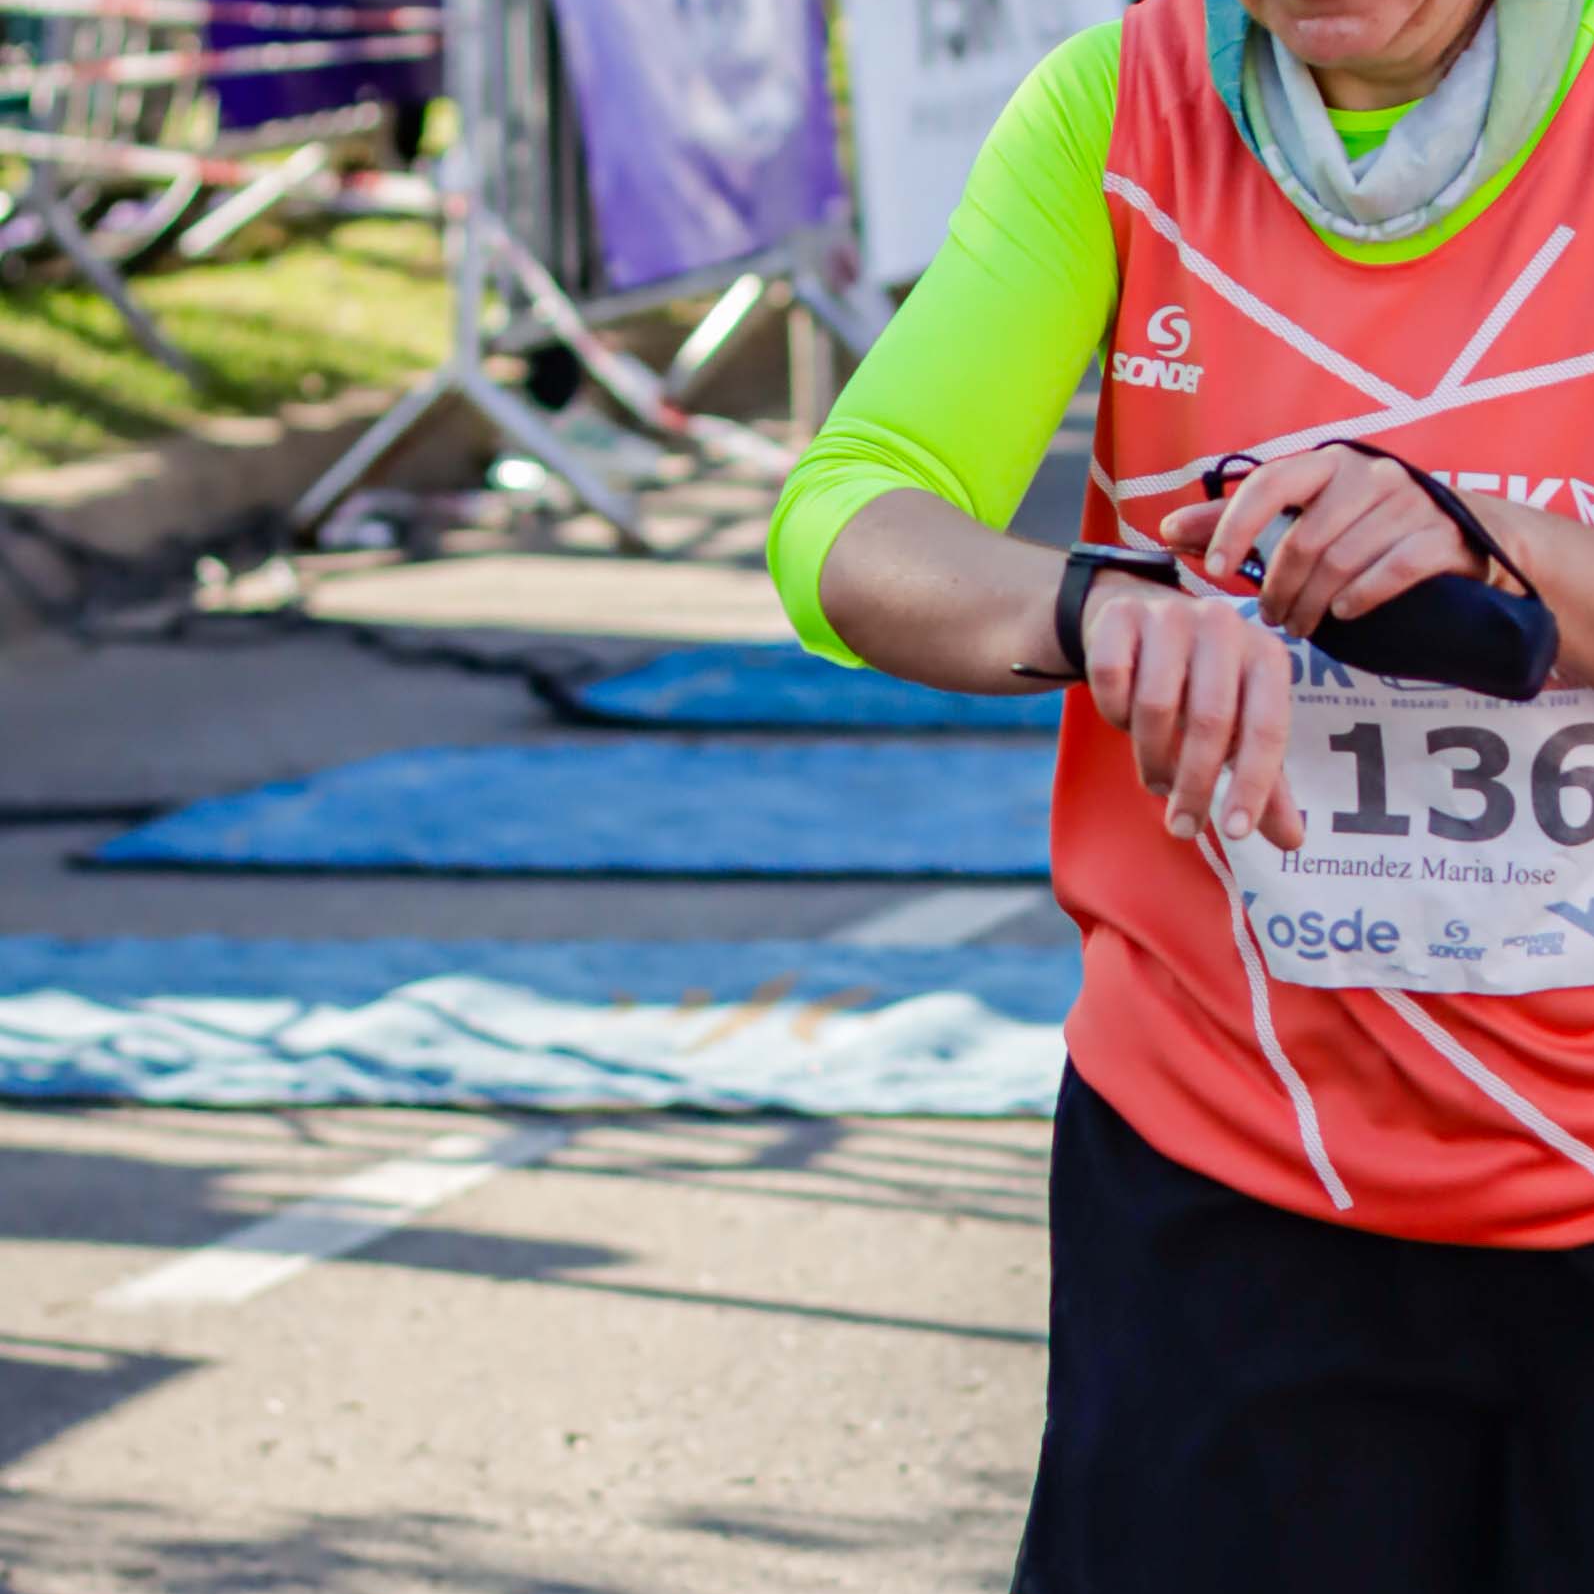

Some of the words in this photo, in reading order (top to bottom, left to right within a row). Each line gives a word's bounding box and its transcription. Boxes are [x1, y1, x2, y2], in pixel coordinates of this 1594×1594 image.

[1280, 851, 1412, 880] Hernandez
[1420, 857, 1494, 884] Maria
[1501, 861, 1556, 885] Jose
[1267, 907, 1400, 960] osde
